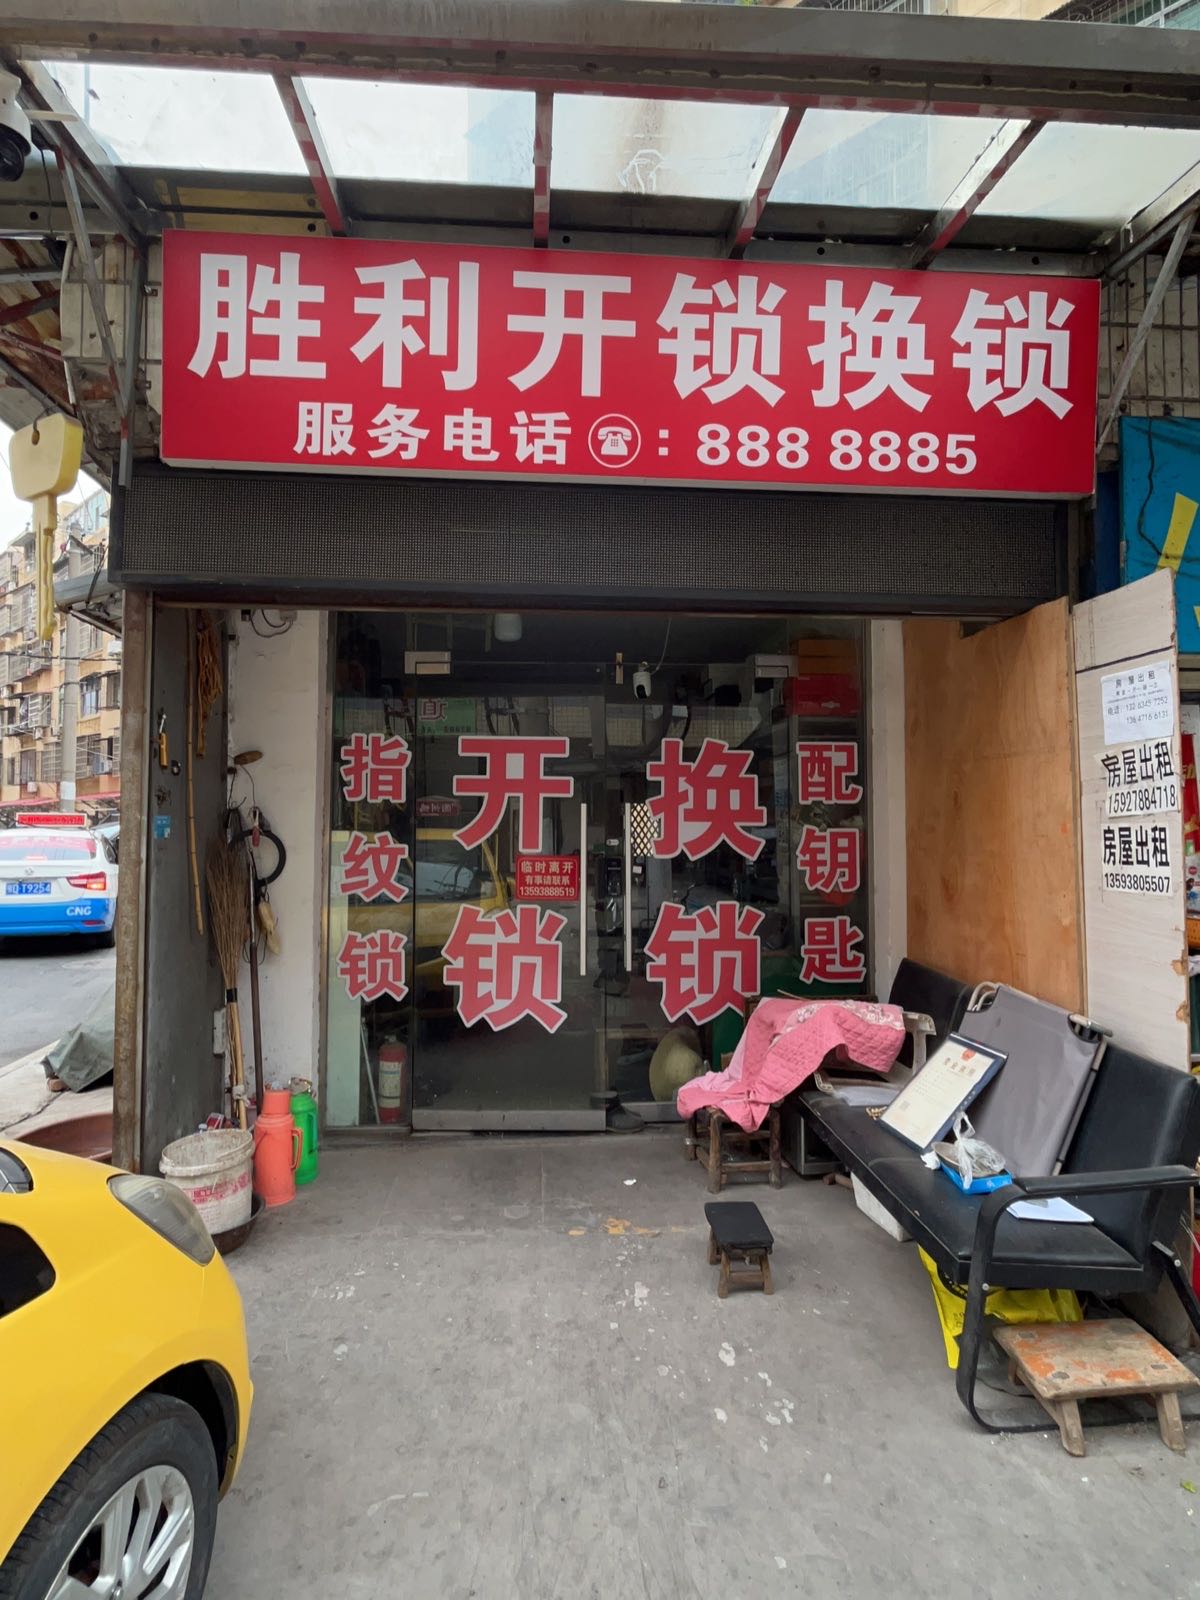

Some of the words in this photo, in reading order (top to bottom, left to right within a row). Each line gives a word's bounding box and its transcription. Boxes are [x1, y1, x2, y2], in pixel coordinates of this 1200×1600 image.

[188, 252, 1073, 419] 胜利开锁换锁
[697, 424, 809, 470] 888
[830, 429, 977, 475] 8885
[1101, 741, 1174, 788] 房屋出租
[1108, 784, 1176, 814] 15927884718
[337, 733, 412, 1002] 指纹锁
[521, 860, 573, 874] 临时离开
[796, 742, 866, 983] 配钥匙
[1103, 825, 1170, 868] 房屋出租
[525, 875, 570, 886] 有事请联系
[1104, 873, 1170, 893] 13593805507
[66, 906, 92, 917] CNG
